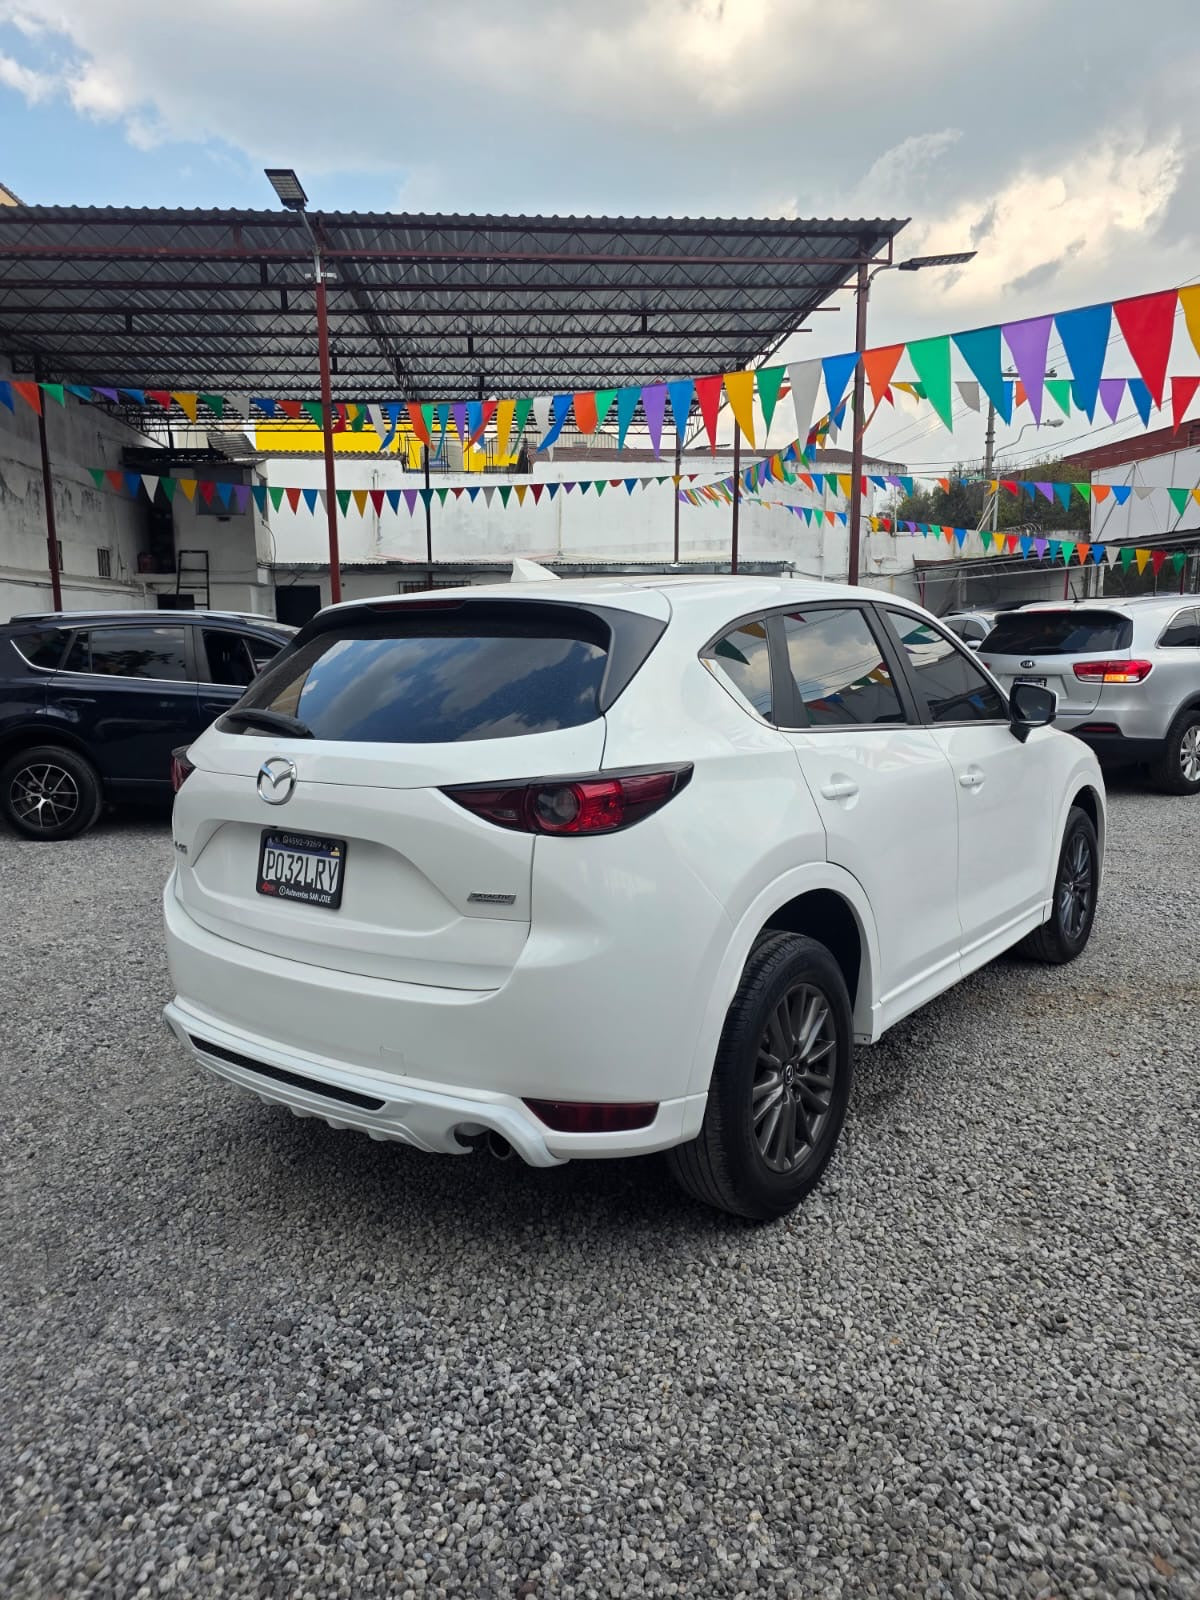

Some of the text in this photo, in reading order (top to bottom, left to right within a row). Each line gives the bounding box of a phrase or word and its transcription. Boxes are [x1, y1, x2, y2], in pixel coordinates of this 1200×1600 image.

[265, 850, 338, 891] P032LRY
[286, 888, 309, 899] Autoventas
[309, 892, 319, 901] SAN
